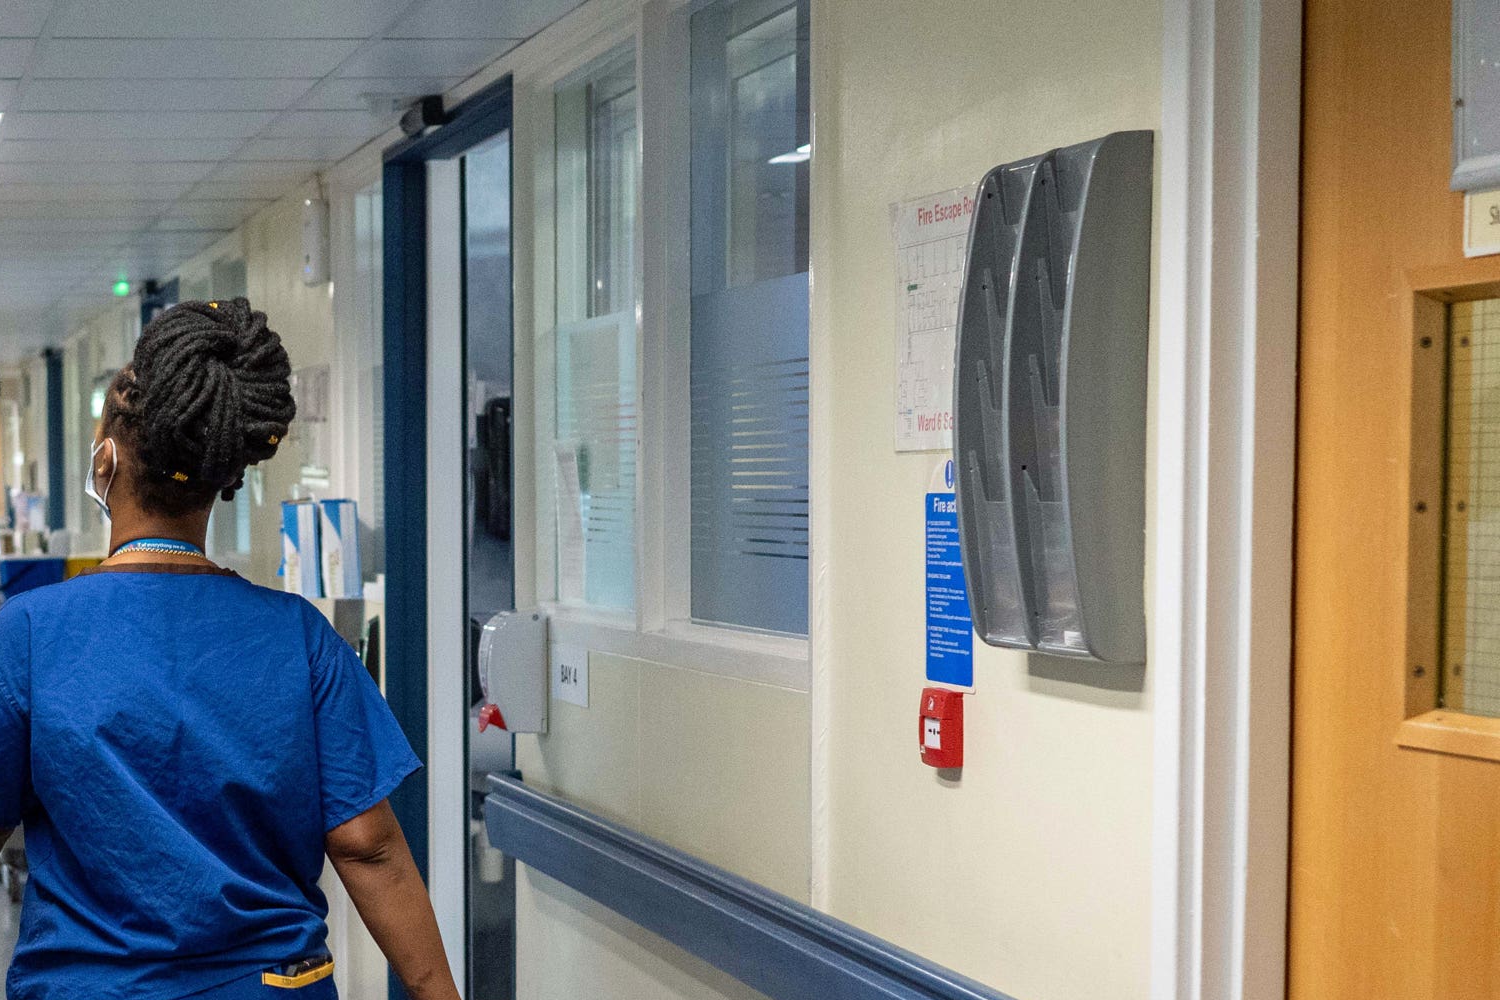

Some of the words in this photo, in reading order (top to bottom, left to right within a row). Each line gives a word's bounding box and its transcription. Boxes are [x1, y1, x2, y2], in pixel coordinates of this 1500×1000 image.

[918, 207, 933, 226] Fire
[934, 203, 962, 223] Escape
[917, 412, 936, 432] Ward
[933, 497, 946, 513] Fire
[561, 664, 572, 684] BAY
[573, 668, 577, 686] 4
